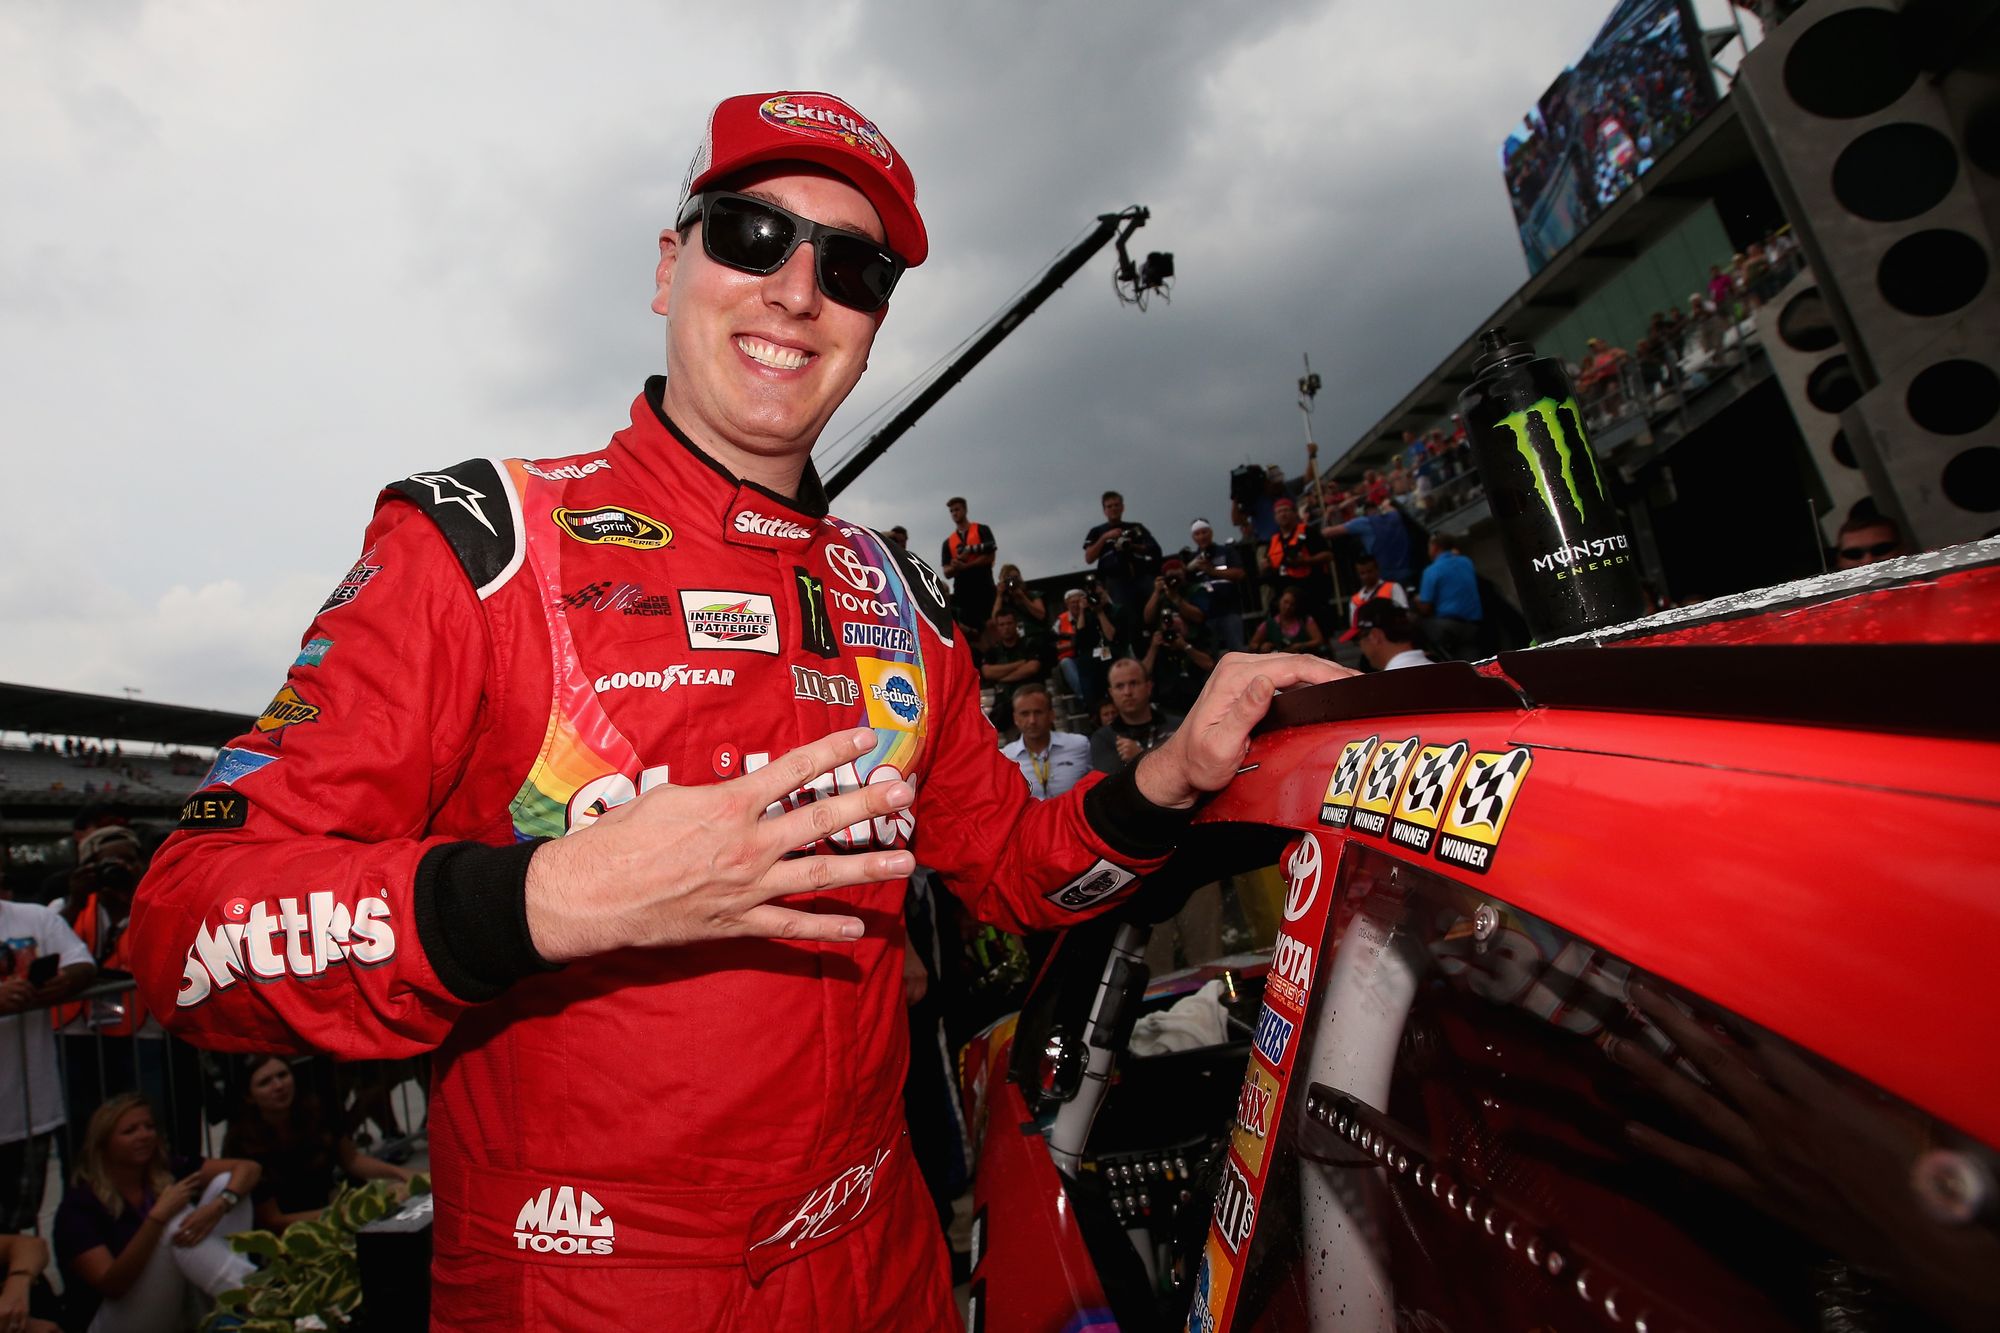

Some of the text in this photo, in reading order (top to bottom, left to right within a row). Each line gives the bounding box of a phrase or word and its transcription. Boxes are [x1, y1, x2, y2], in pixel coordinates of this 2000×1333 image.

[774, 103, 888, 159] Skittles
[583, 512, 625, 525] NASCAR
[592, 521, 634, 535] Sprint
[734, 510, 812, 540] Skittles
[627, 537, 662, 547] SERIES
[1531, 534, 1629, 572] MONSTE
[1556, 553, 1632, 580] ENERGY
[623, 608, 672, 616] RACING
[829, 588, 900, 618] TOYOT
[689, 612, 771, 624] INTERSTATE
[694, 623, 769, 634] BATTERIES
[1321, 805, 1349, 824] WINNER
[1353, 810, 1385, 833] WINNER
[1391, 821, 1430, 849] WINNER
[1440, 837, 1489, 868] WINNER
[1272, 929, 1313, 991] YOTA
[515, 1186, 614, 1237] MAC
[512, 1231, 614, 1255] TOOLS
